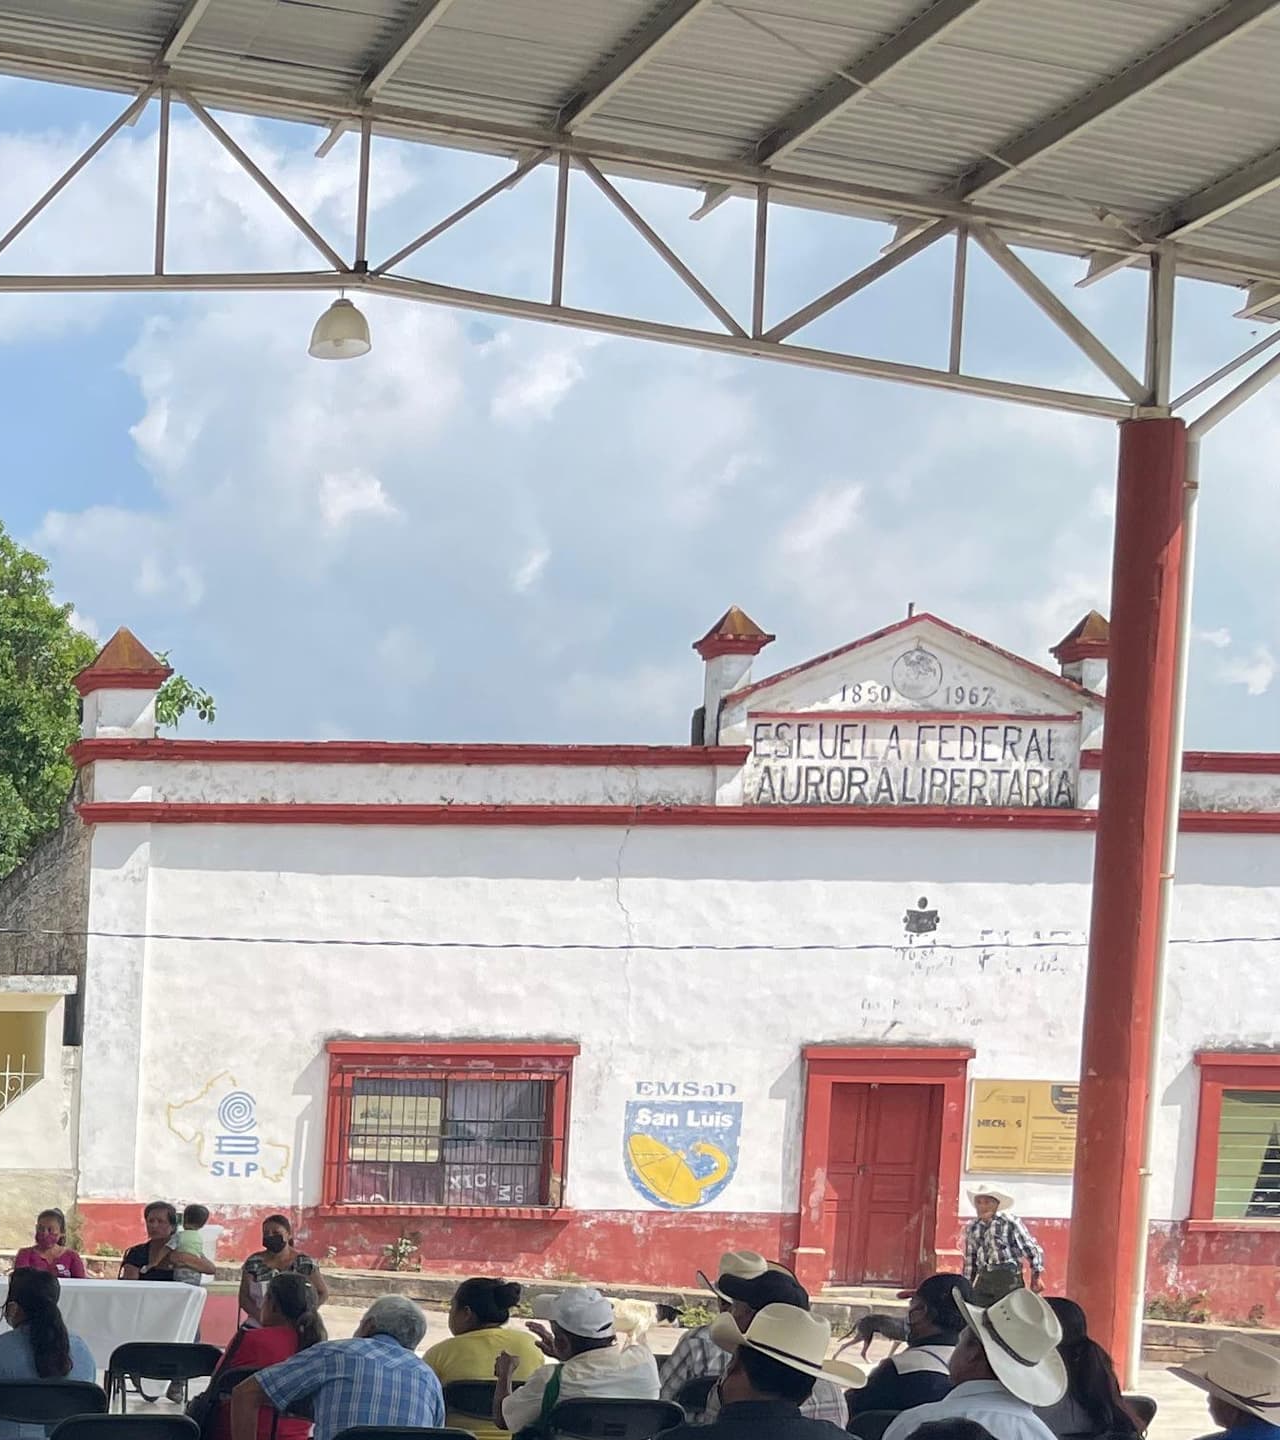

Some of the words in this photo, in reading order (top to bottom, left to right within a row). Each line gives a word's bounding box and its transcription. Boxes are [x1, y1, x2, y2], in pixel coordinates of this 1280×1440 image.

[840, 683, 891, 704] 1850
[946, 685, 996, 707] 1967
[753, 722, 902, 761] ESCUELA
[915, 724, 1055, 762] FEDERAL
[756, 765, 899, 802] AURORA
[635, 1106, 679, 1127] San
[686, 1108, 734, 1128] Luis
[210, 1160, 260, 1178] SLP
